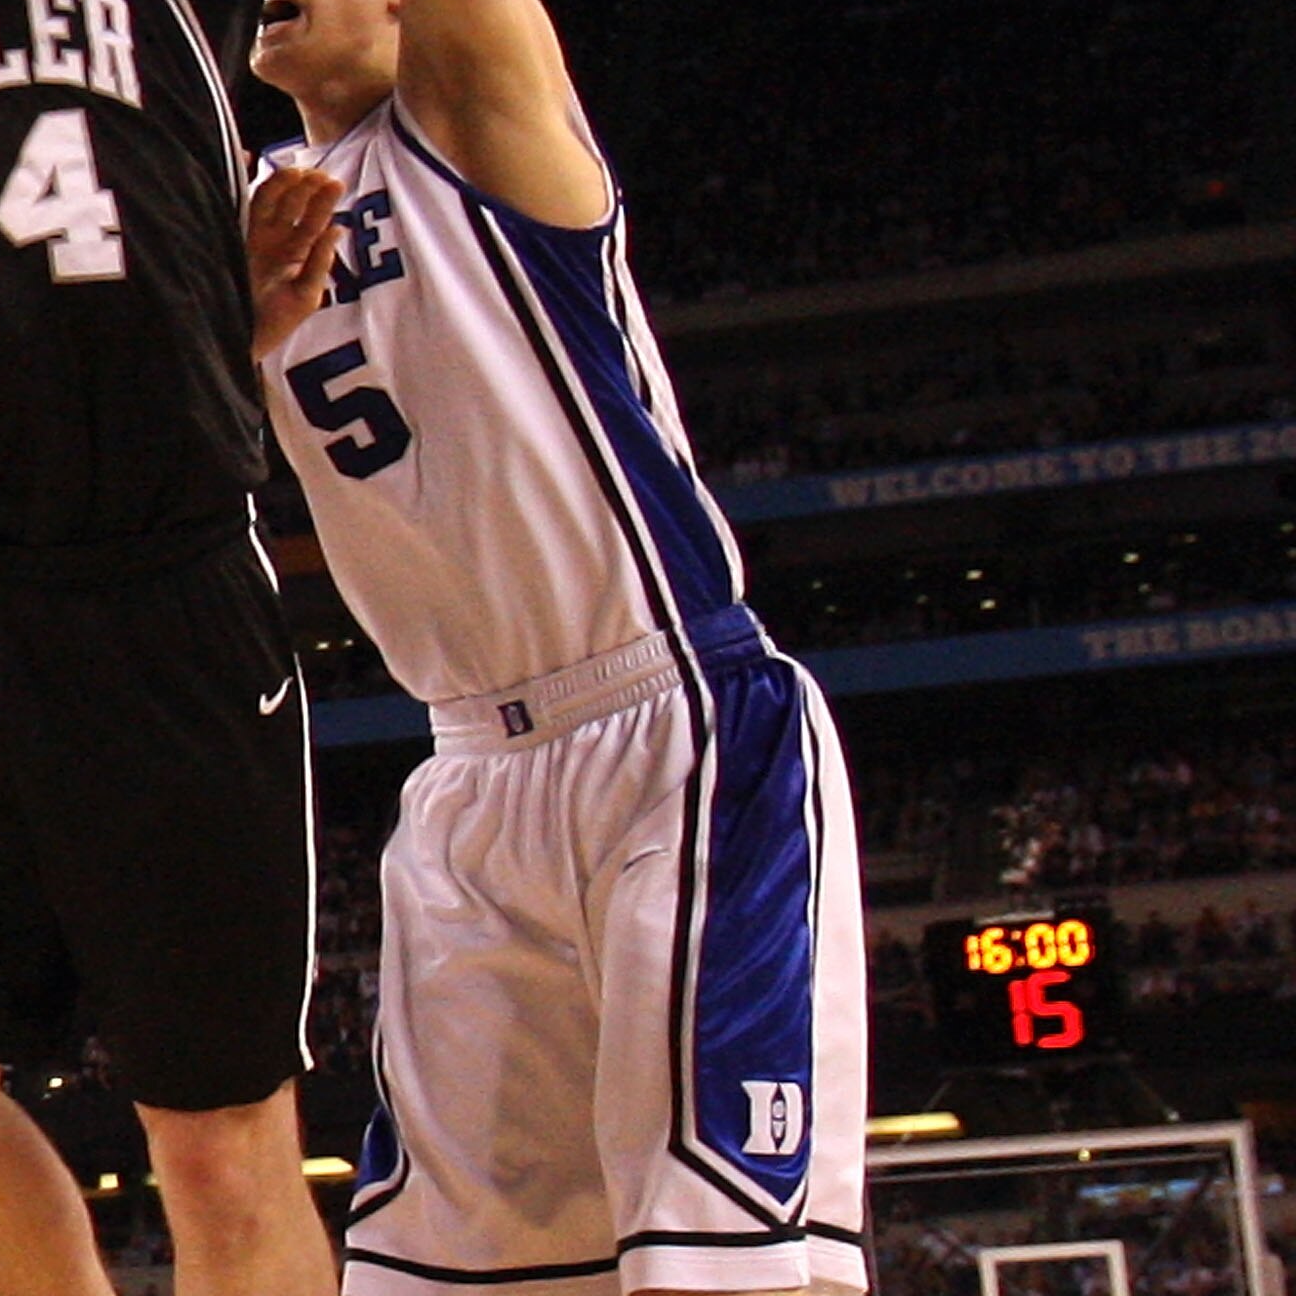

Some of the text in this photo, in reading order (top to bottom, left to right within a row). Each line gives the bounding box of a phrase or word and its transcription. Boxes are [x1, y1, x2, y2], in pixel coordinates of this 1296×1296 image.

[284, 338, 412, 480] 5
[830, 451, 1066, 506] WELCOME
[1070, 444, 1138, 480] TO
[1151, 434, 1244, 472] THE
[1082, 620, 1180, 661] THE
[965, 919, 1092, 974] 16:00
[1008, 969, 1084, 1049] 15
